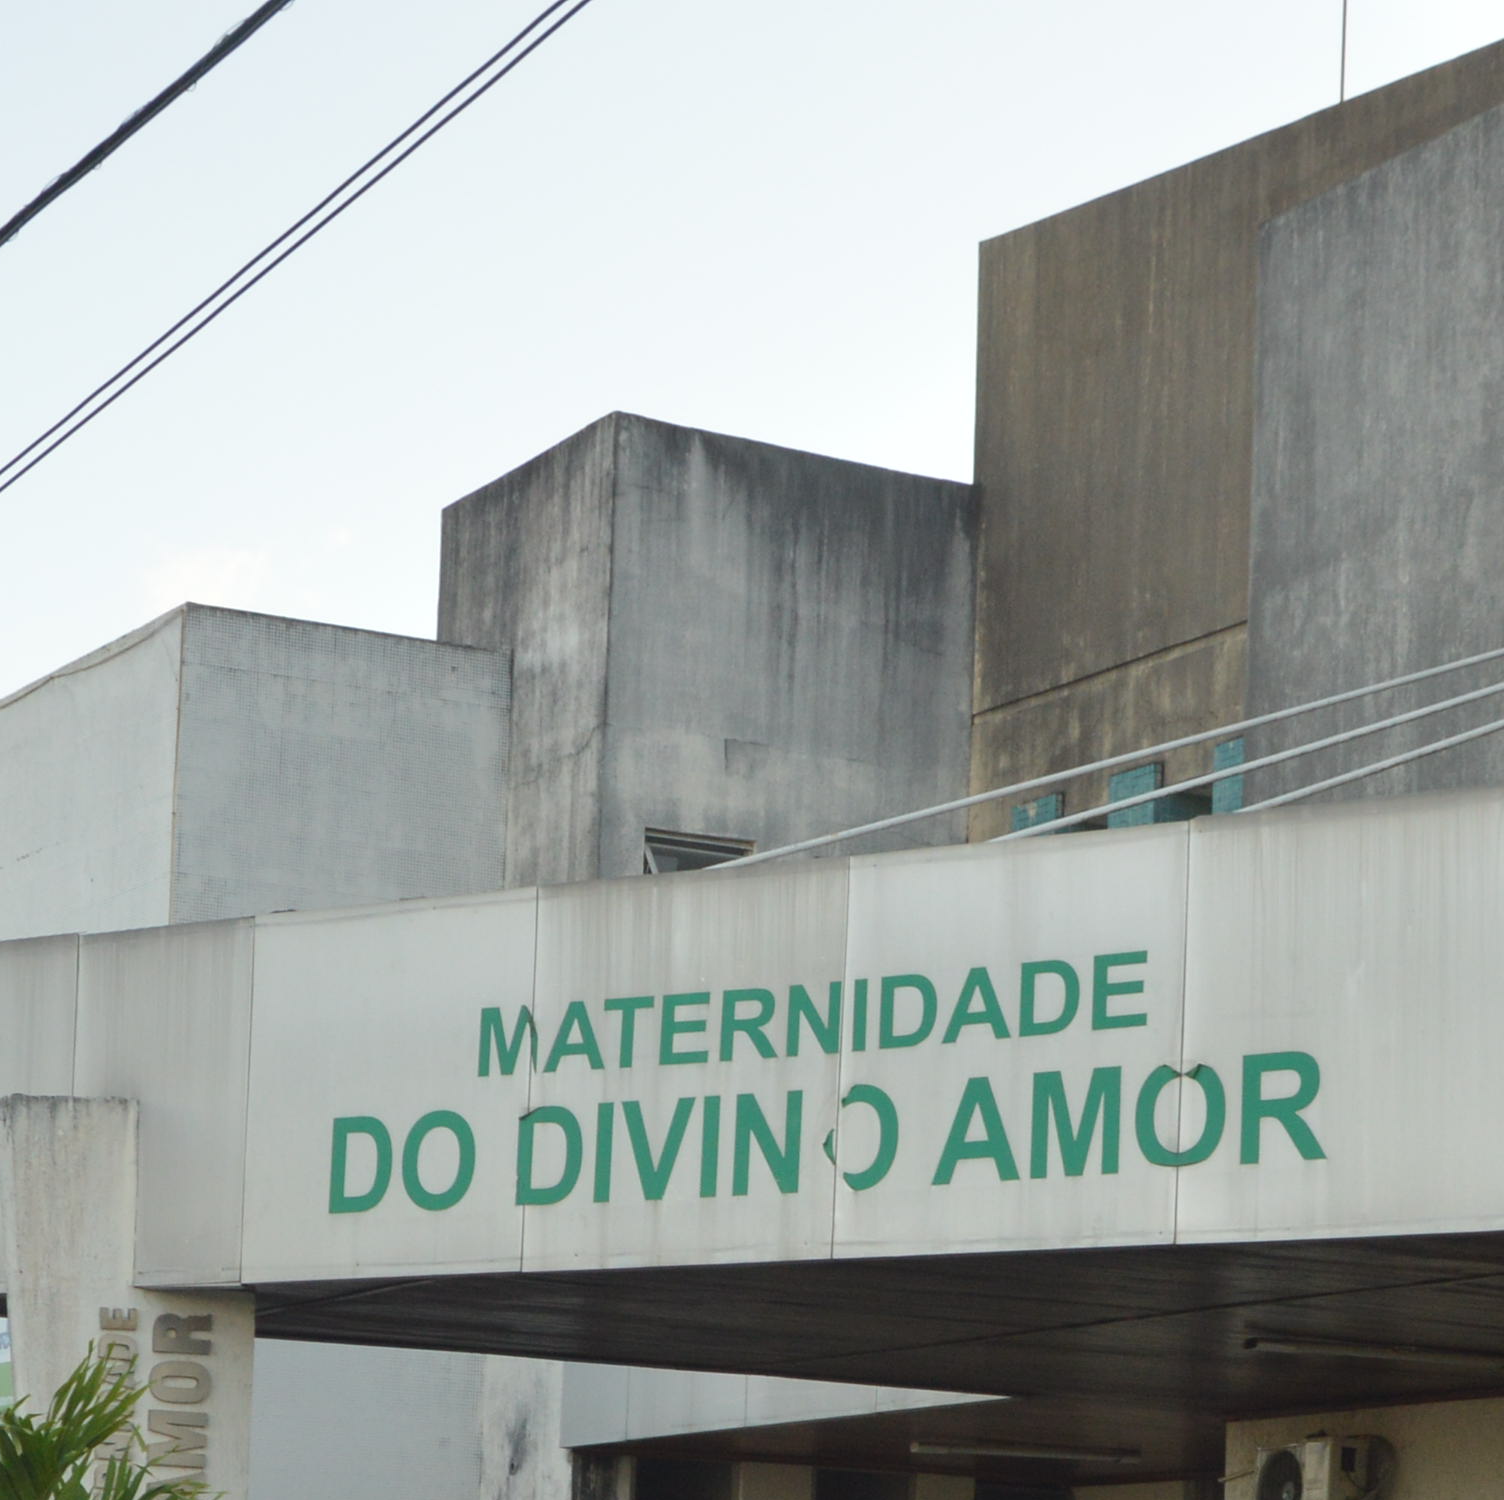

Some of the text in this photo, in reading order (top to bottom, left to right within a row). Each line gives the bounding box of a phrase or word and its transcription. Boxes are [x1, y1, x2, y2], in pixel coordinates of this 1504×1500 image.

[477, 949, 1150, 1077] MATERNIDADE
[328, 1050, 1328, 1214] DO DIVINO AMOR
